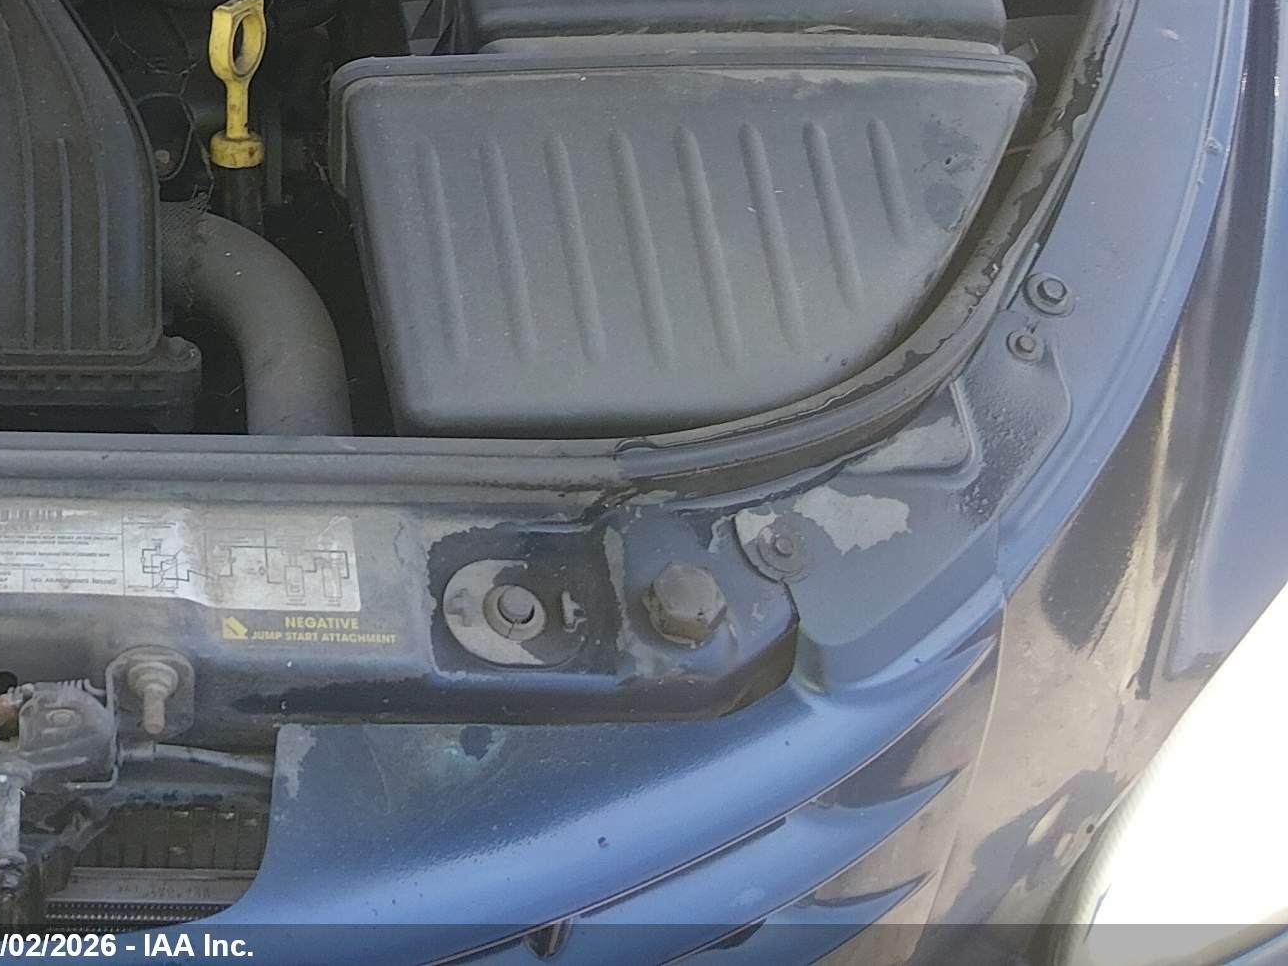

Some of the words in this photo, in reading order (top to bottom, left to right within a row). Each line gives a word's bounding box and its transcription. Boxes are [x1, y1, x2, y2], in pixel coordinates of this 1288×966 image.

[285, 616, 359, 630] NEGATIVE
[250, 631, 282, 641] JUMP
[285, 632, 318, 642] START
[320, 633, 397, 644] ATTACHMENT
